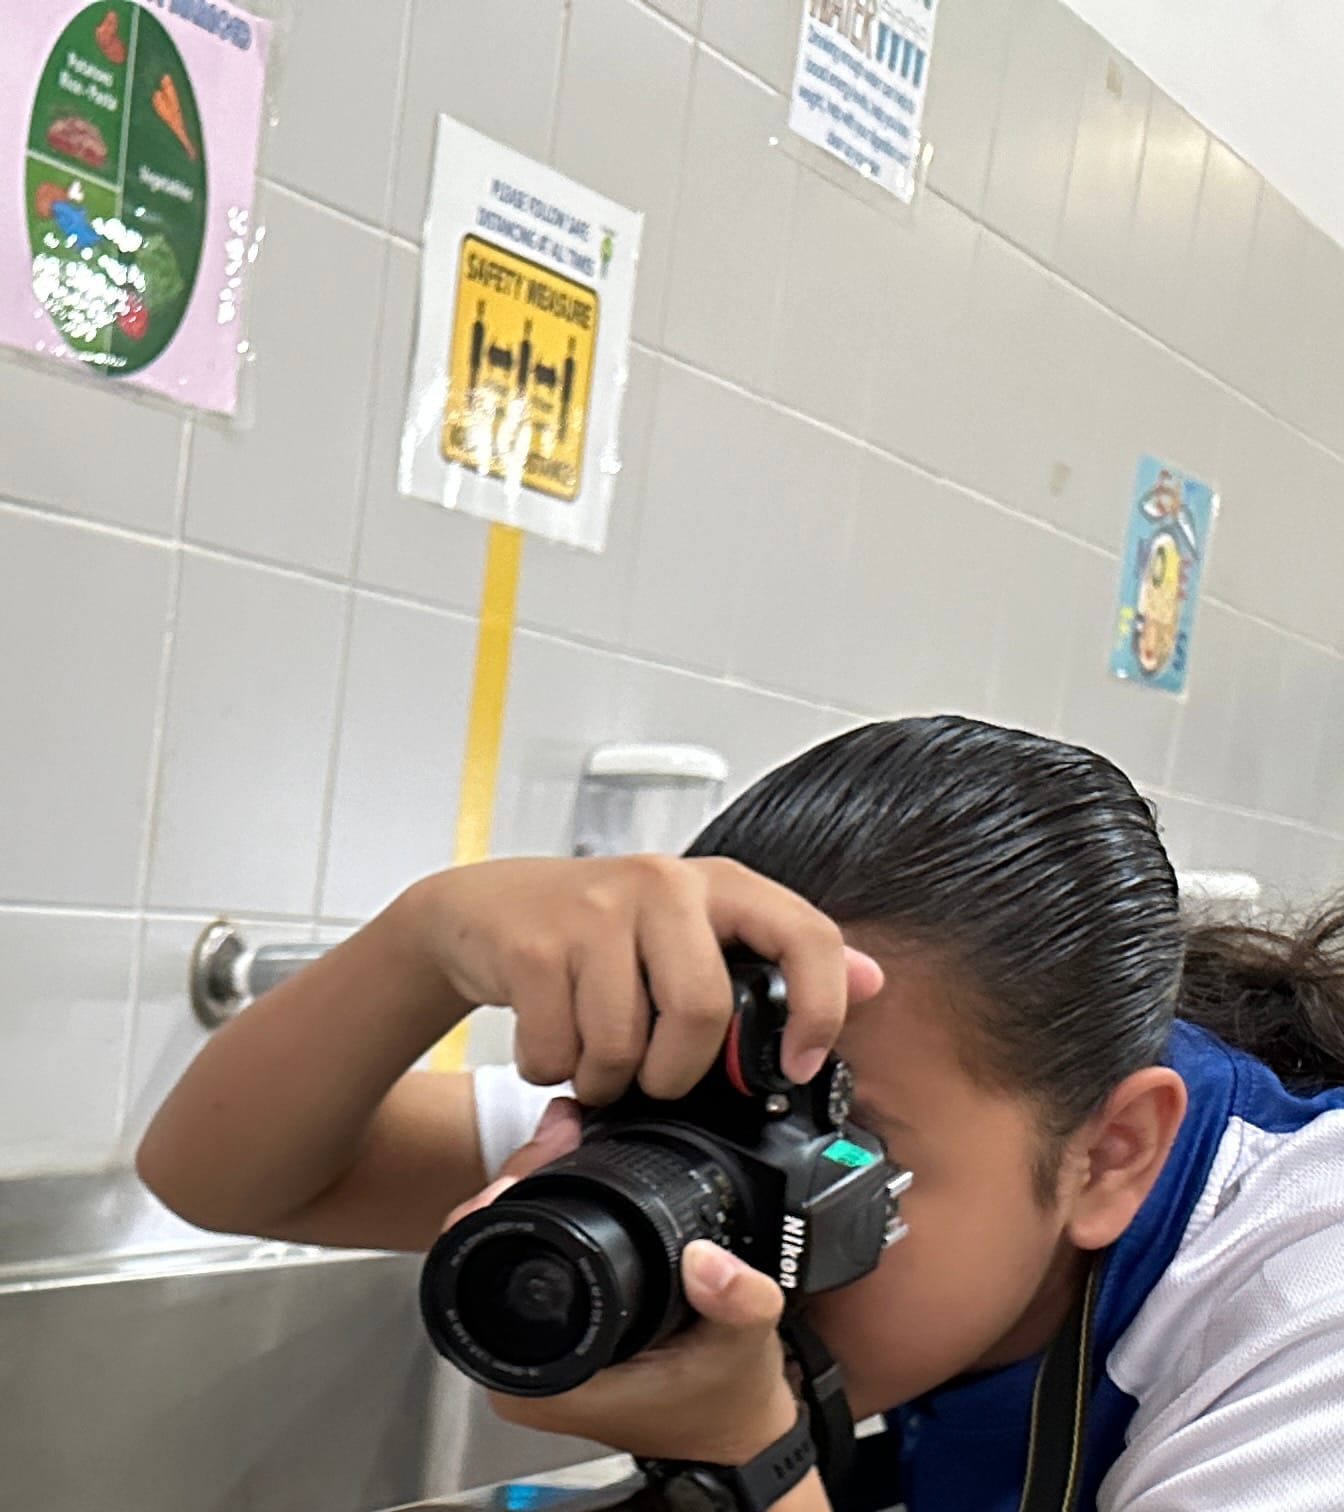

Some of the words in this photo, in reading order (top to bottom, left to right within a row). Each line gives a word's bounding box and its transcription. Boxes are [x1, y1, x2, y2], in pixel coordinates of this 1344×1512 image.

[466, 252, 523, 301] SAFETY
[525, 278, 593, 331] MEASURE
[779, 1214, 805, 1289] Nikon
